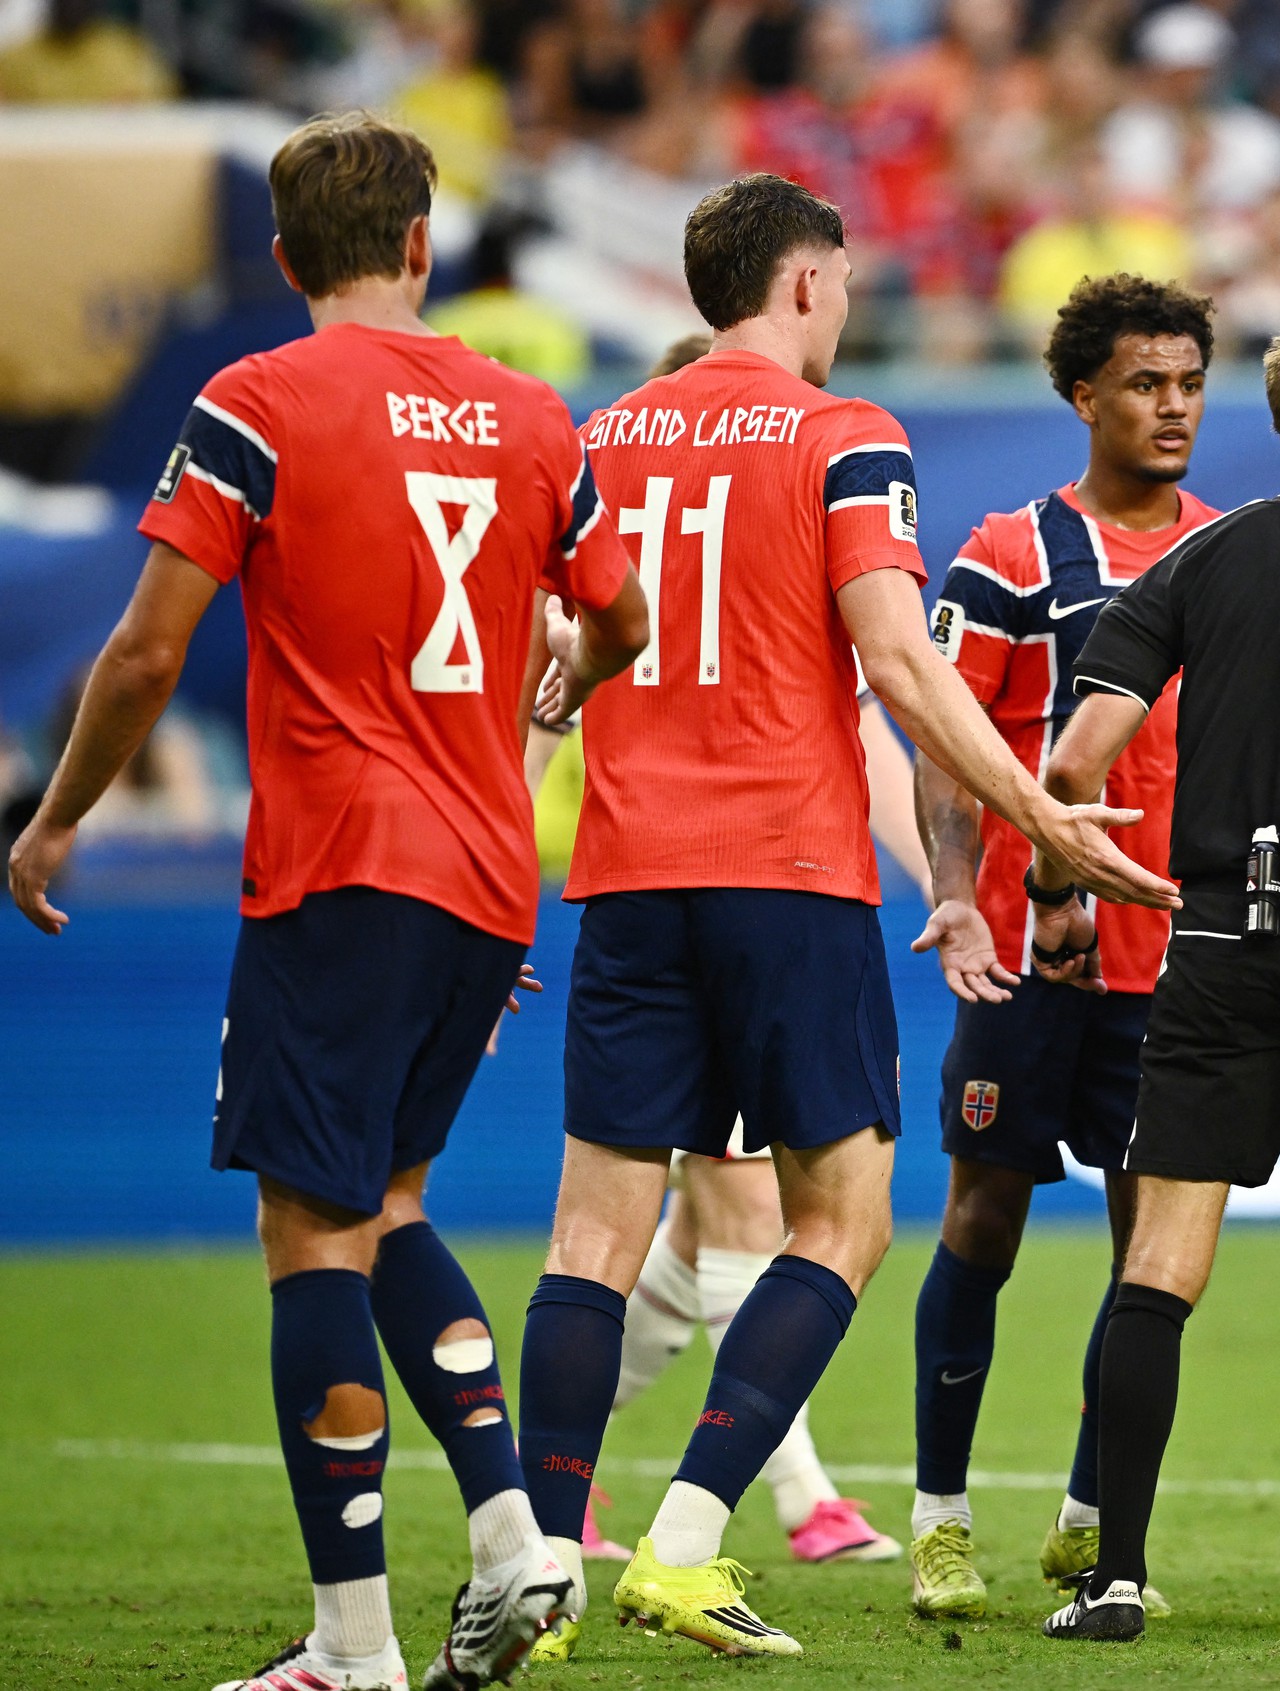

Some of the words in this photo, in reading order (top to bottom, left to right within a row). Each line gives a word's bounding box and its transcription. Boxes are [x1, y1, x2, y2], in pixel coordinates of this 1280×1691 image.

[386, 391, 500, 446] BERGE
[586, 406, 687, 450] STRAND
[693, 405, 805, 447] LARSEN
[404, 471, 498, 694] 8
[618, 475, 732, 686] 11
